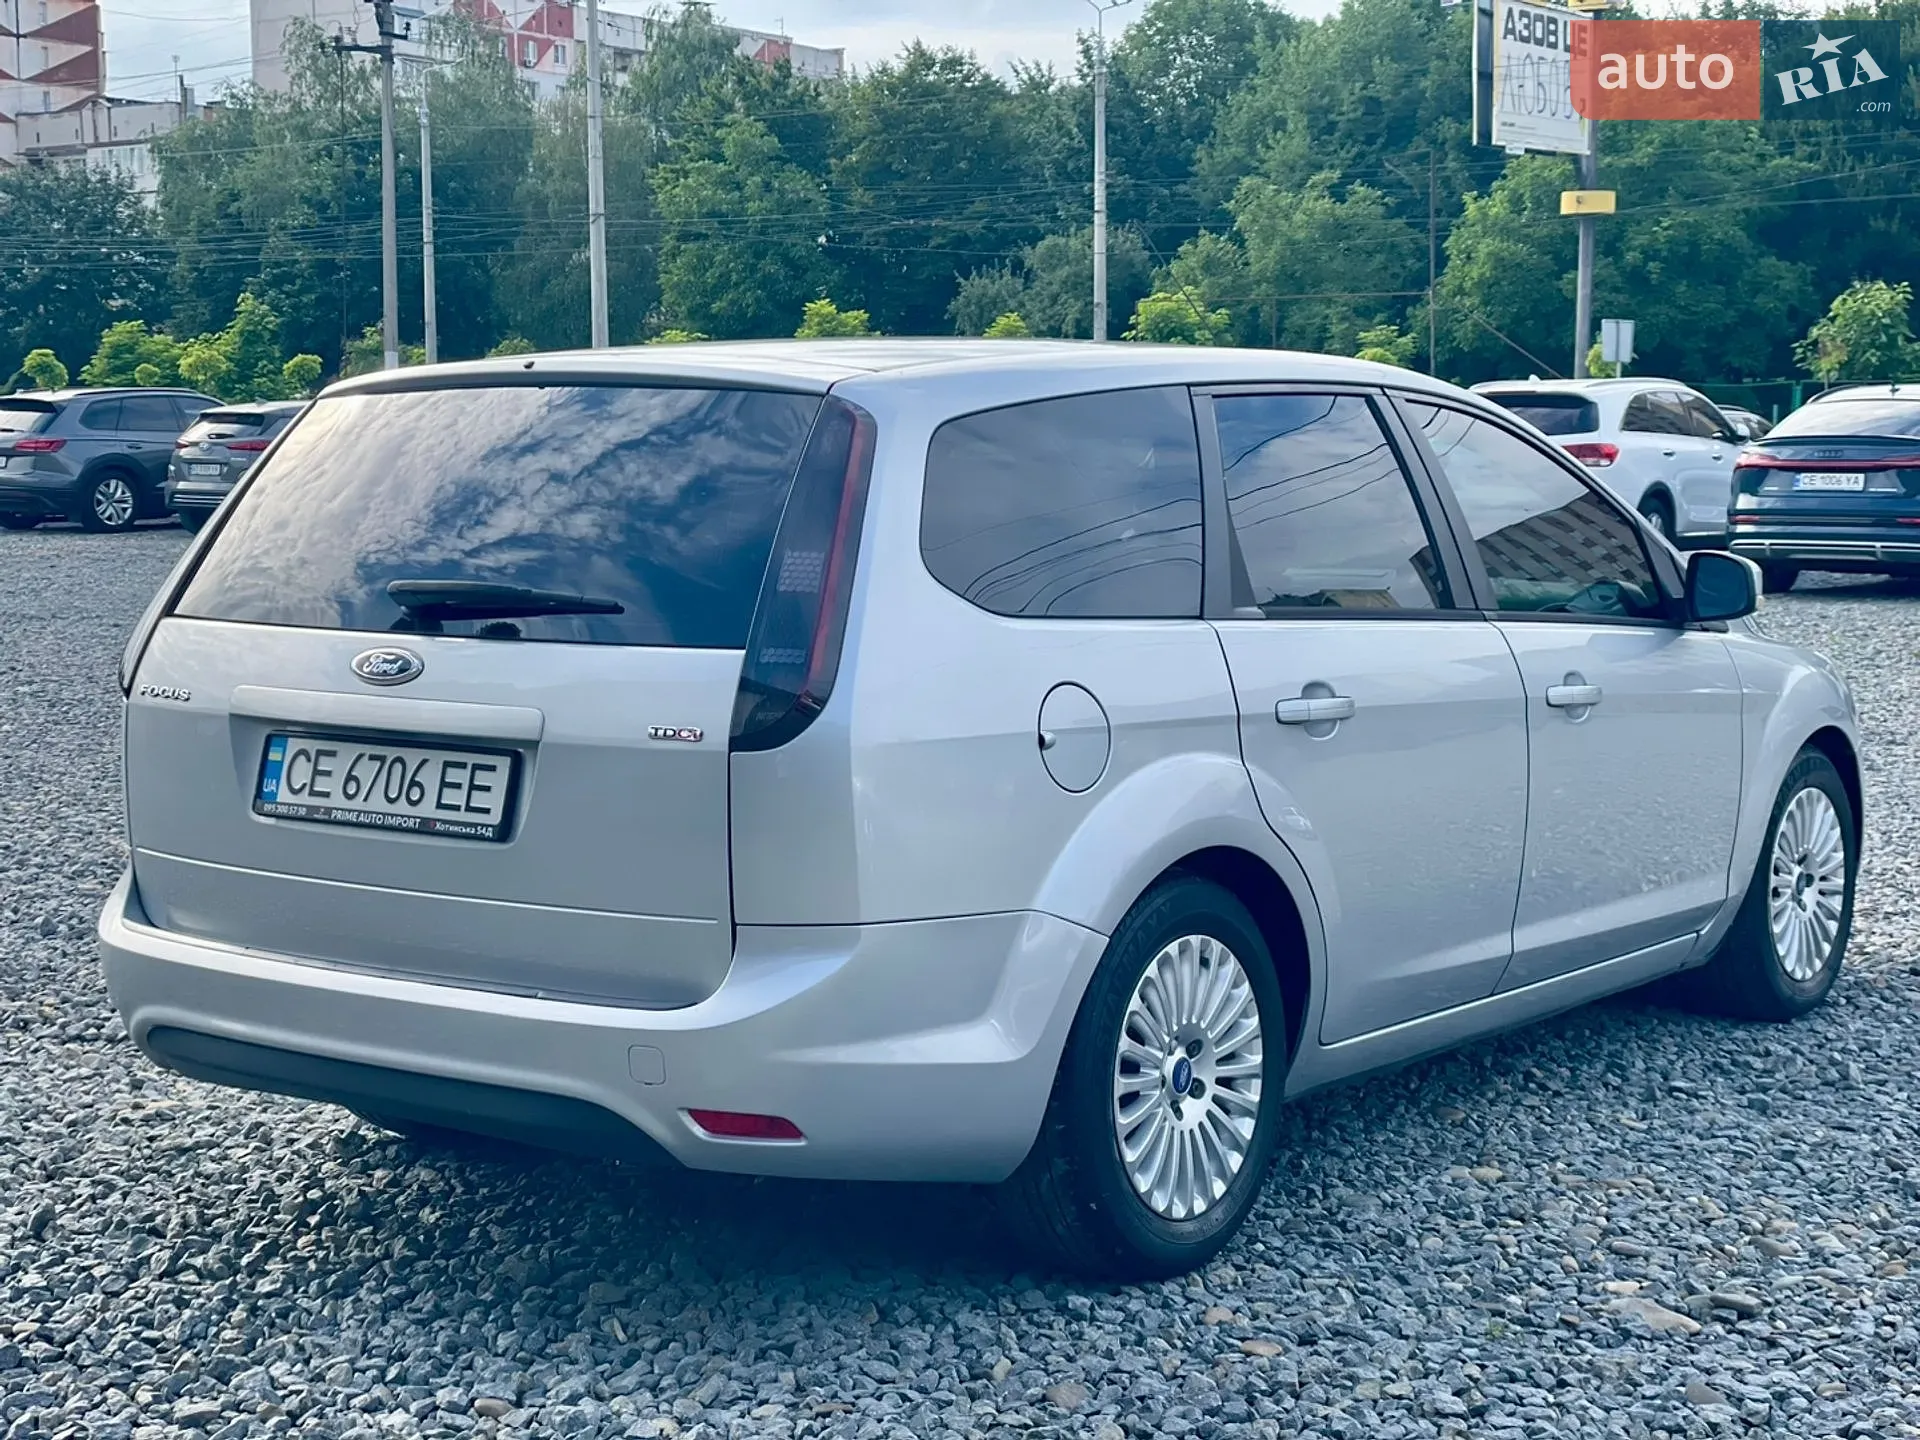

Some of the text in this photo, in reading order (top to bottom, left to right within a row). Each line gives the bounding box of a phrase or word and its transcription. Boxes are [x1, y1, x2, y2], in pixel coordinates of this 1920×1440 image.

[1503, 6, 1559, 50] АЗОВ
[1802, 474, 1817, 486] CE
[363, 653, 403, 675] Ford
[140, 684, 191, 701] FOCUS
[262, 777, 278, 793] UA
[286, 748, 497, 815] CE 6706 EE
[331, 809, 357, 821] PRIME
[358, 811, 383, 825] AUTO
[384, 815, 421, 829] IMPORT
